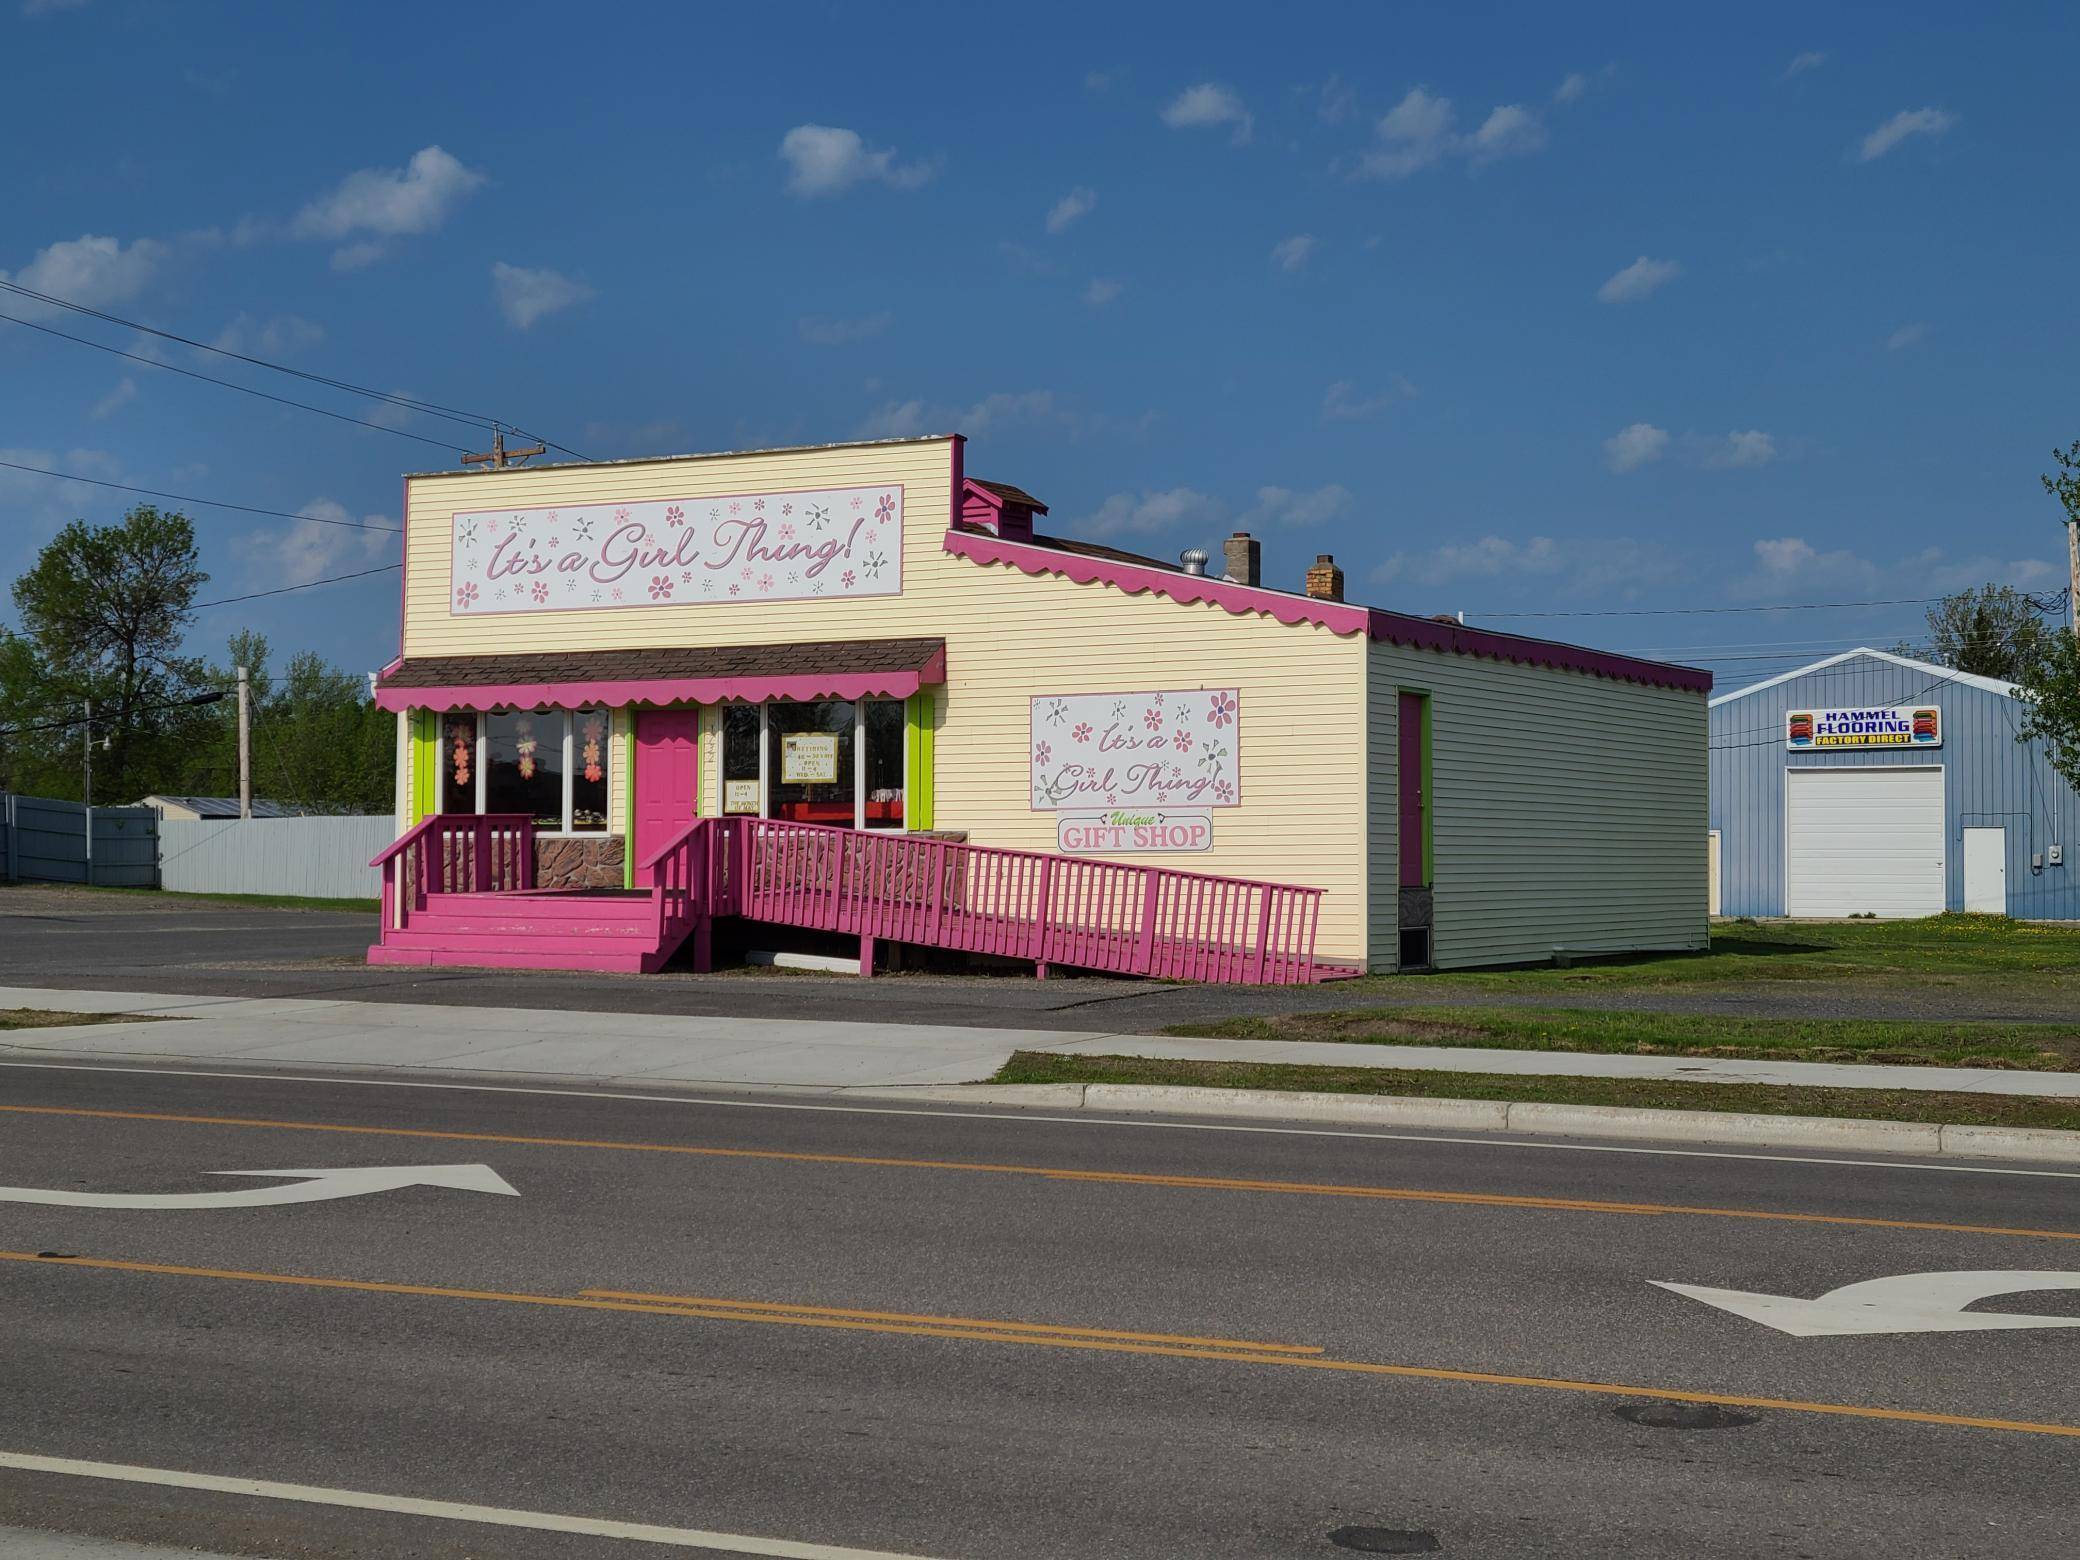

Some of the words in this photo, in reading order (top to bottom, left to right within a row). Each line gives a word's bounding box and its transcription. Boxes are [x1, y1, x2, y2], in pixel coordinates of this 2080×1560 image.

[486, 532, 553, 581] It's
[556, 550, 592, 573] a
[588, 522, 700, 584] Girl
[703, 516, 865, 579] Thing!
[1825, 710, 1901, 721] HAMMEL
[1098, 722, 1144, 753] It's
[1146, 734, 1169, 750] a
[1817, 720, 1910, 734] FLOORING
[1816, 735, 1867, 745] FACTORY
[1868, 734, 1910, 744] DIRECT
[1048, 764, 1118, 800] Girl
[1110, 811, 1156, 831] Unique
[1063, 826, 1126, 849] GIFT
[1133, 825, 1206, 848] SHOP
